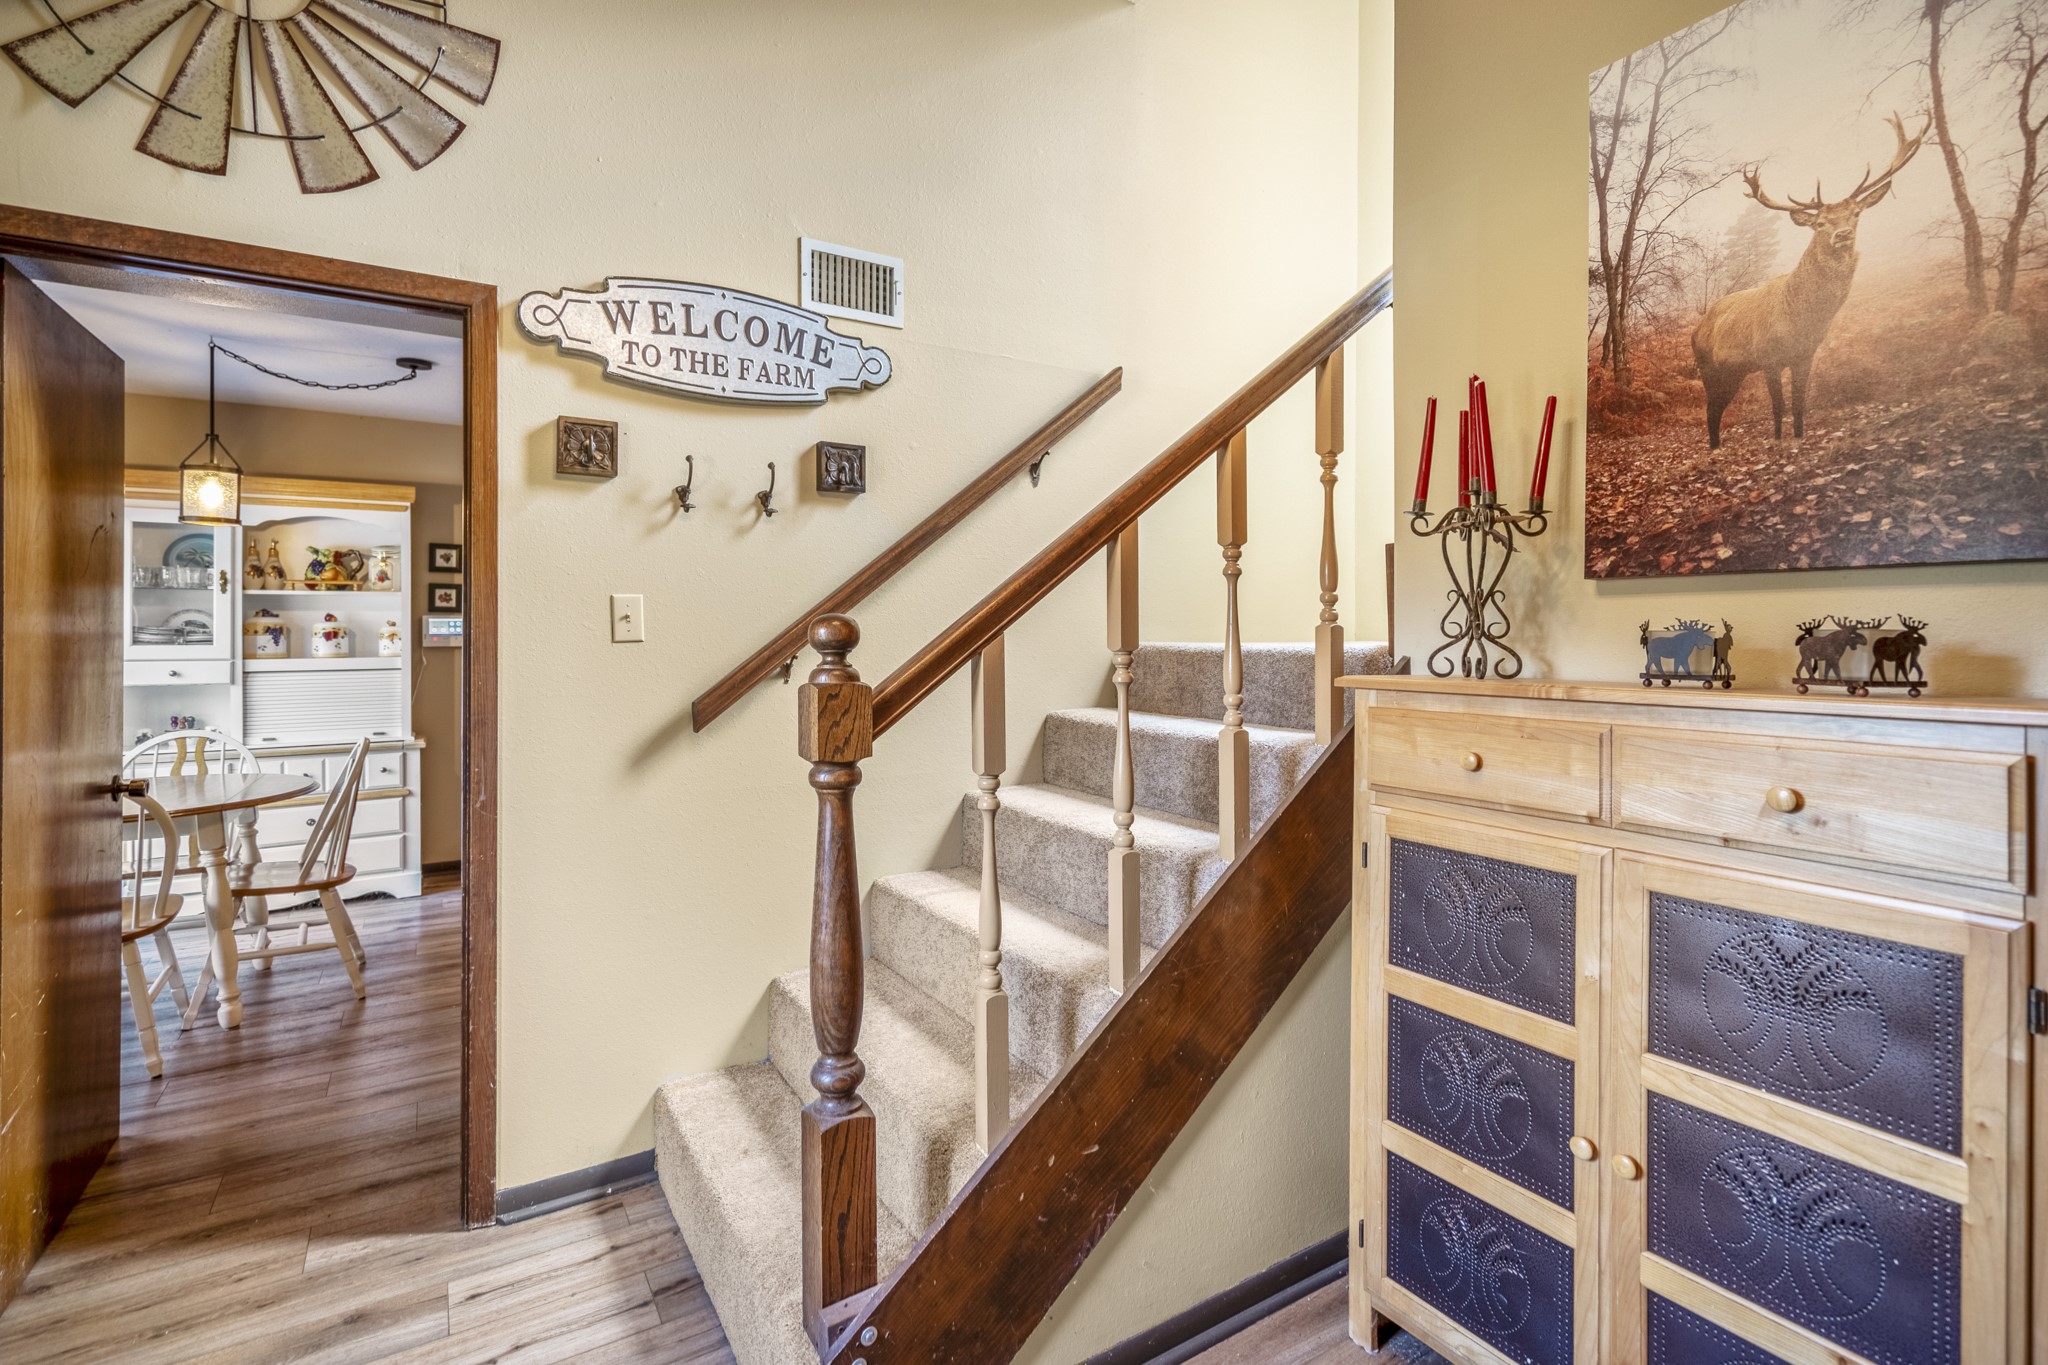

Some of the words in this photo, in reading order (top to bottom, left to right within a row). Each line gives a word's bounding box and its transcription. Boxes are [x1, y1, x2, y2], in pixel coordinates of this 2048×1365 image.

[596, 300, 837, 369] WELCOME
[621, 340, 662, 368] TO
[669, 347, 730, 378] THE
[737, 359, 816, 391] FARM
